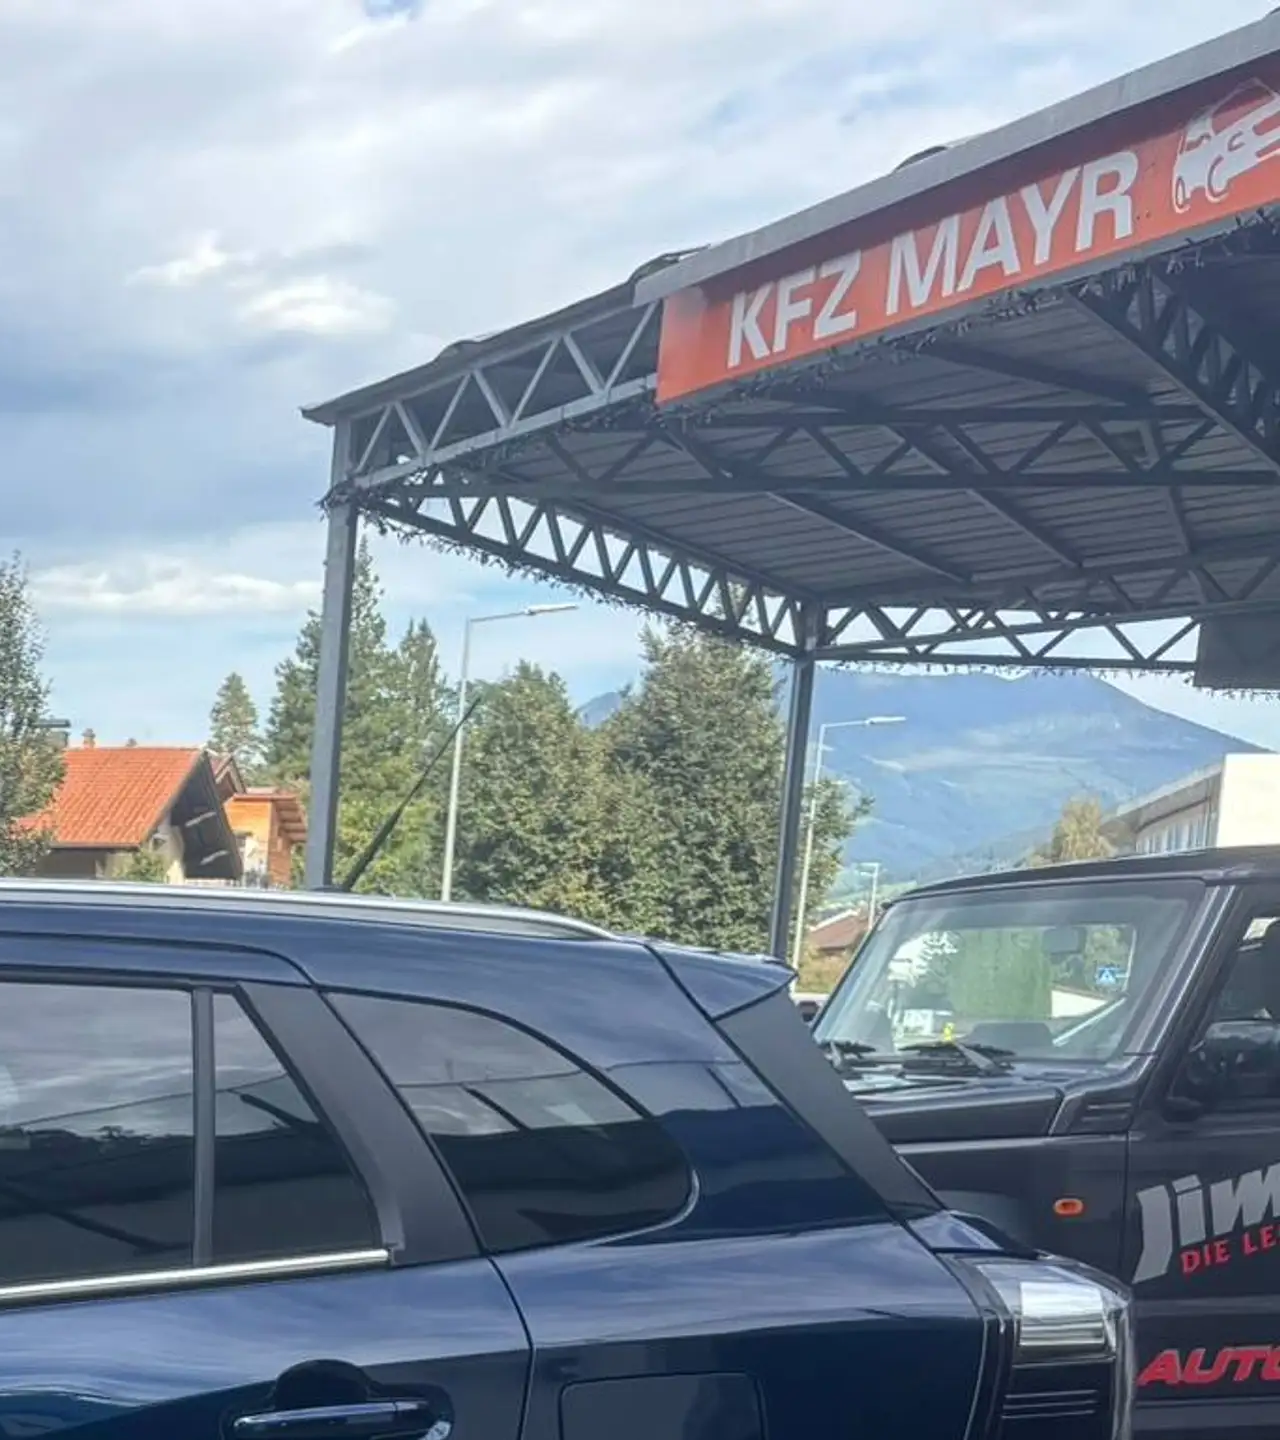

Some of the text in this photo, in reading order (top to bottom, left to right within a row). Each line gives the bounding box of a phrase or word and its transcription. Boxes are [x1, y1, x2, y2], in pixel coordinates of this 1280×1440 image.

[727, 150, 1139, 369] KFZ MAYR
[1180, 1224, 1280, 1276] DIE LE
